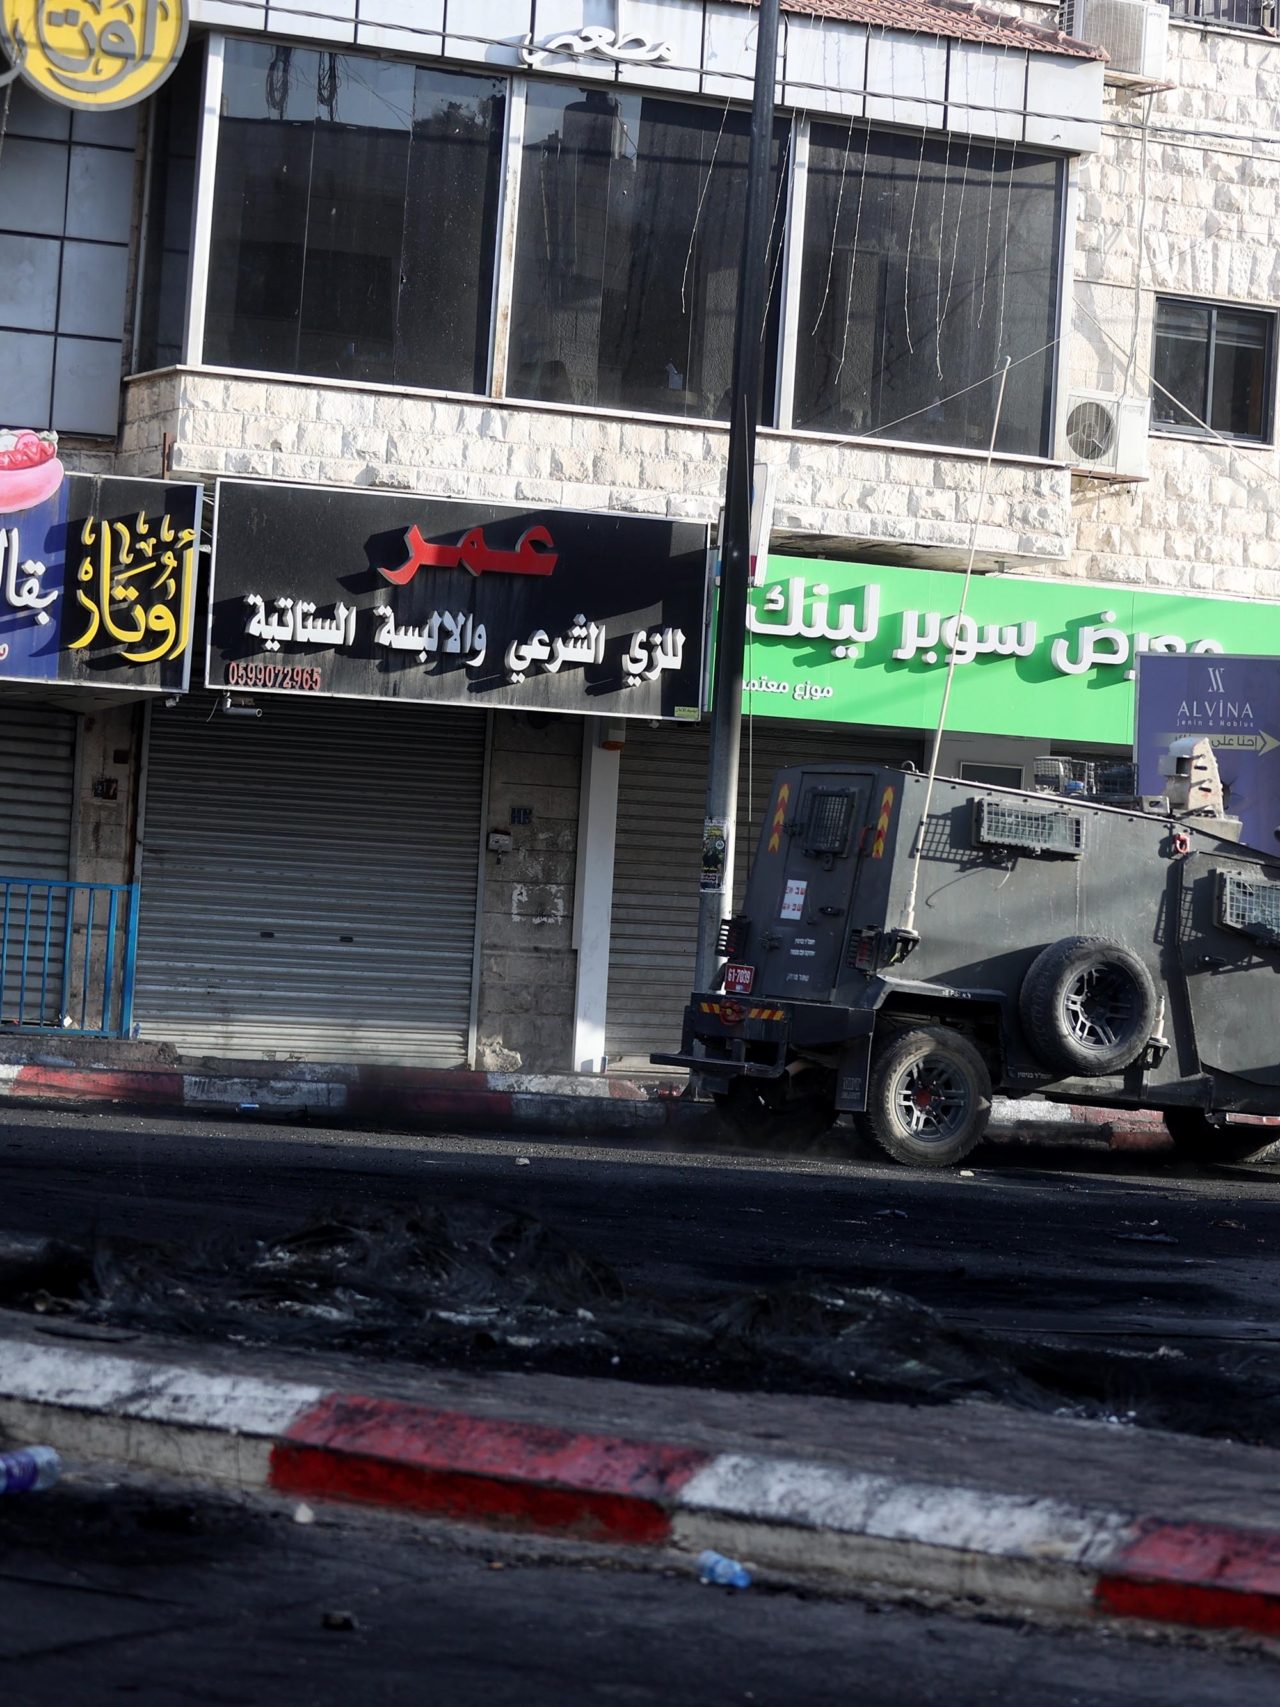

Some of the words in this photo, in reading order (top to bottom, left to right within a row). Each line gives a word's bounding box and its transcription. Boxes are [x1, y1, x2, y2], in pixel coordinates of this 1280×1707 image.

[377, 524, 559, 585] عمر
[245, 593, 357, 651] الستاتية
[373, 604, 488, 667] والالبسة
[745, 576, 881, 660] لينك
[892, 610, 1036, 665] سوبر
[228, 661, 321, 689] 0599072965
[504, 613, 606, 684] الشرعي
[622, 628, 686, 687] للزي
[793, 680, 833, 701] موزع
